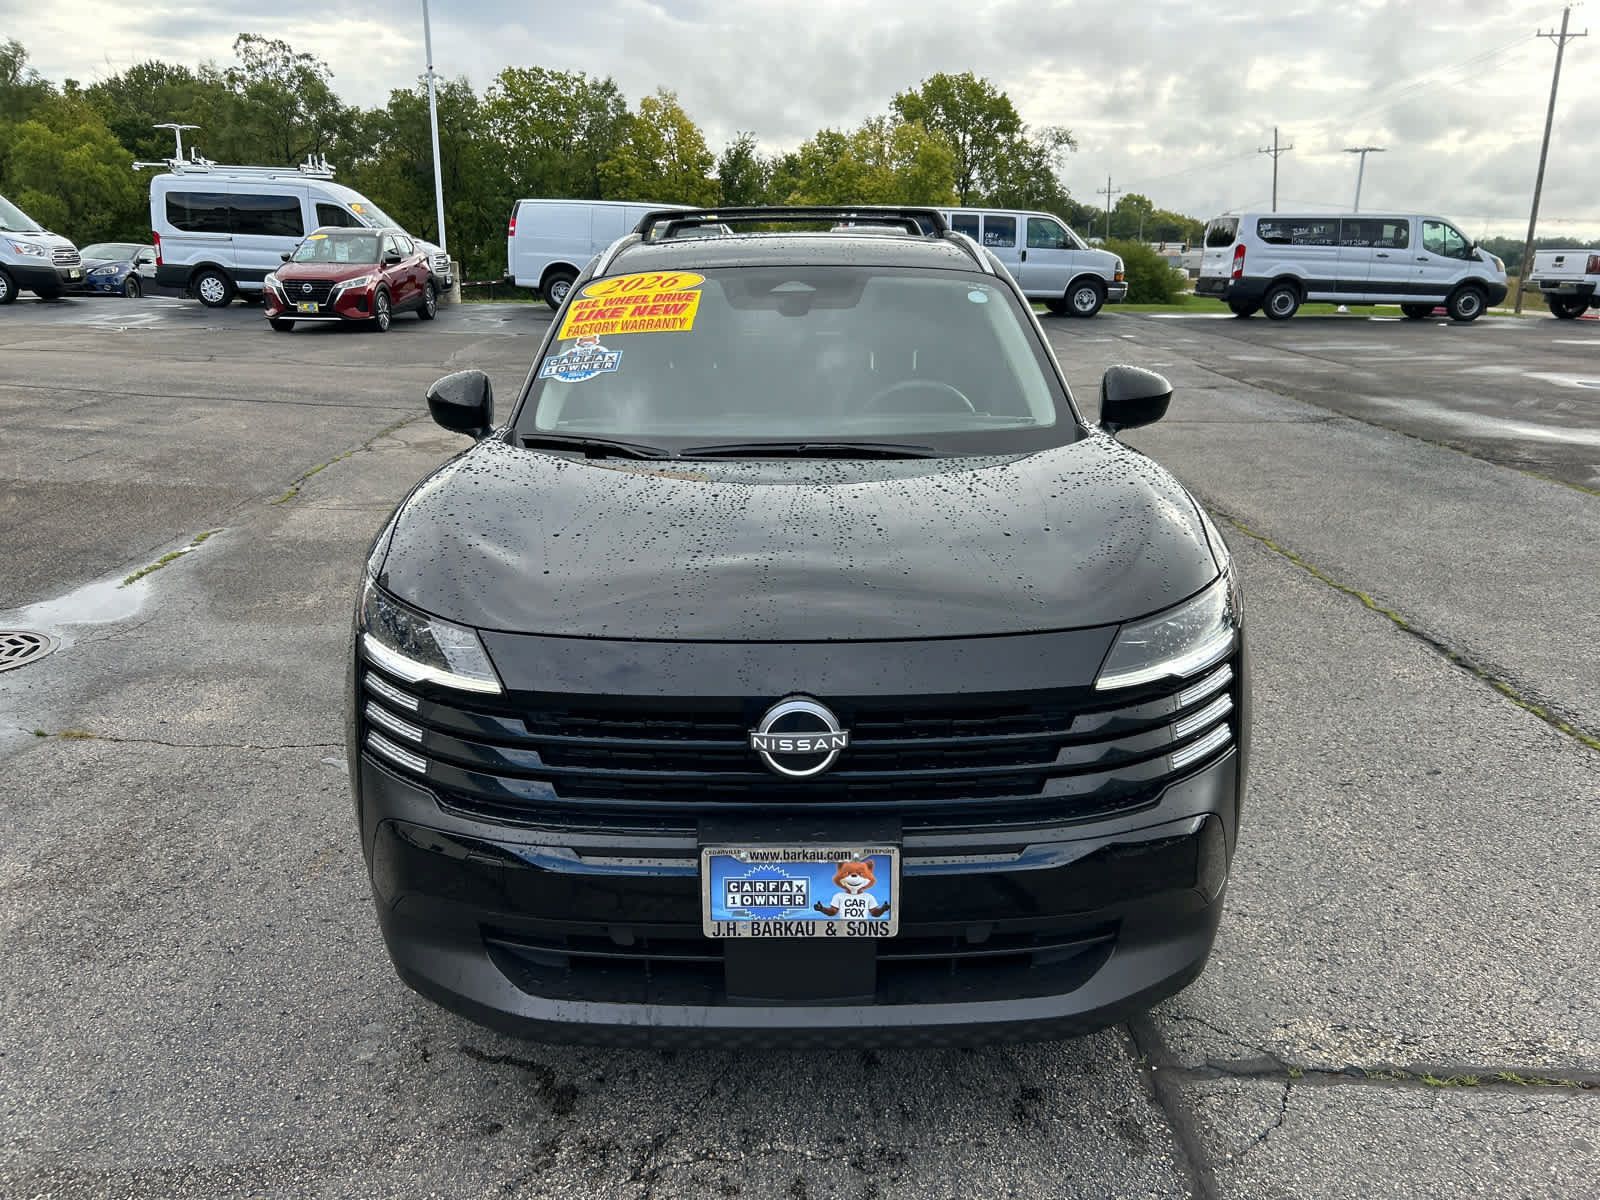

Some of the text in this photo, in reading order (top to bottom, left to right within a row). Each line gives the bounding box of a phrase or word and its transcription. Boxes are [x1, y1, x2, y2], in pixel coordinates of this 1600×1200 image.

[602, 274, 680, 294] 2026
[573, 292, 698, 311] ALL WHEEL DRIVE
[572, 303, 691, 323] LIKE NEW
[566, 318, 688, 337] FACTORY WARRANTY
[550, 354, 616, 366] CARFAX
[558, 363, 613, 373] OWNER
[753, 735, 846, 751] NISSAN
[750, 849, 851, 862] www.barkau.com
[729, 881, 806, 893] CARFAX
[730, 896, 804, 905] 1 OWNER
[844, 898, 866, 908] CAR
[844, 908, 865, 918] FOX
[712, 921, 890, 937] J.H. BARKAU & SONS
